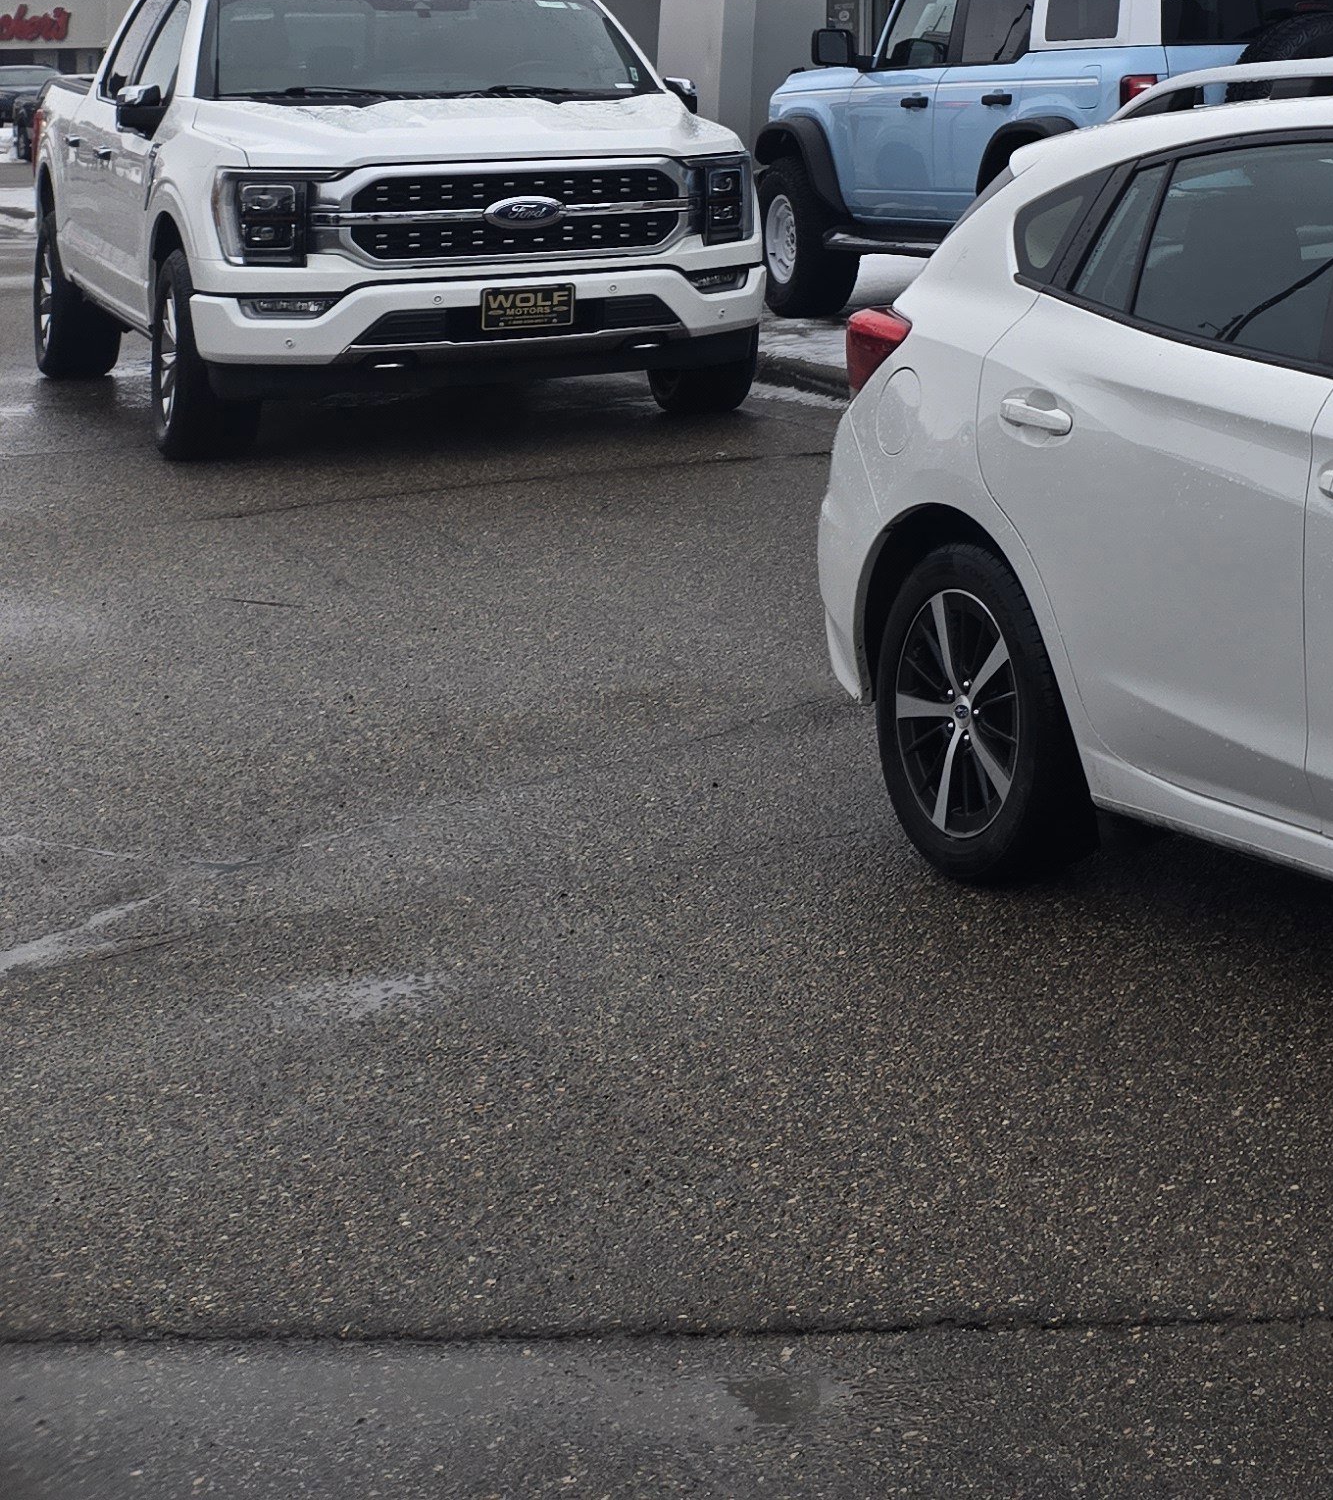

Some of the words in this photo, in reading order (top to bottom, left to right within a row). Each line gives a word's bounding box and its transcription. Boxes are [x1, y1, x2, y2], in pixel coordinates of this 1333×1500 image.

[508, 204, 547, 219] Ford
[487, 290, 570, 309] WOLF
[506, 306, 551, 316] MOTORS
